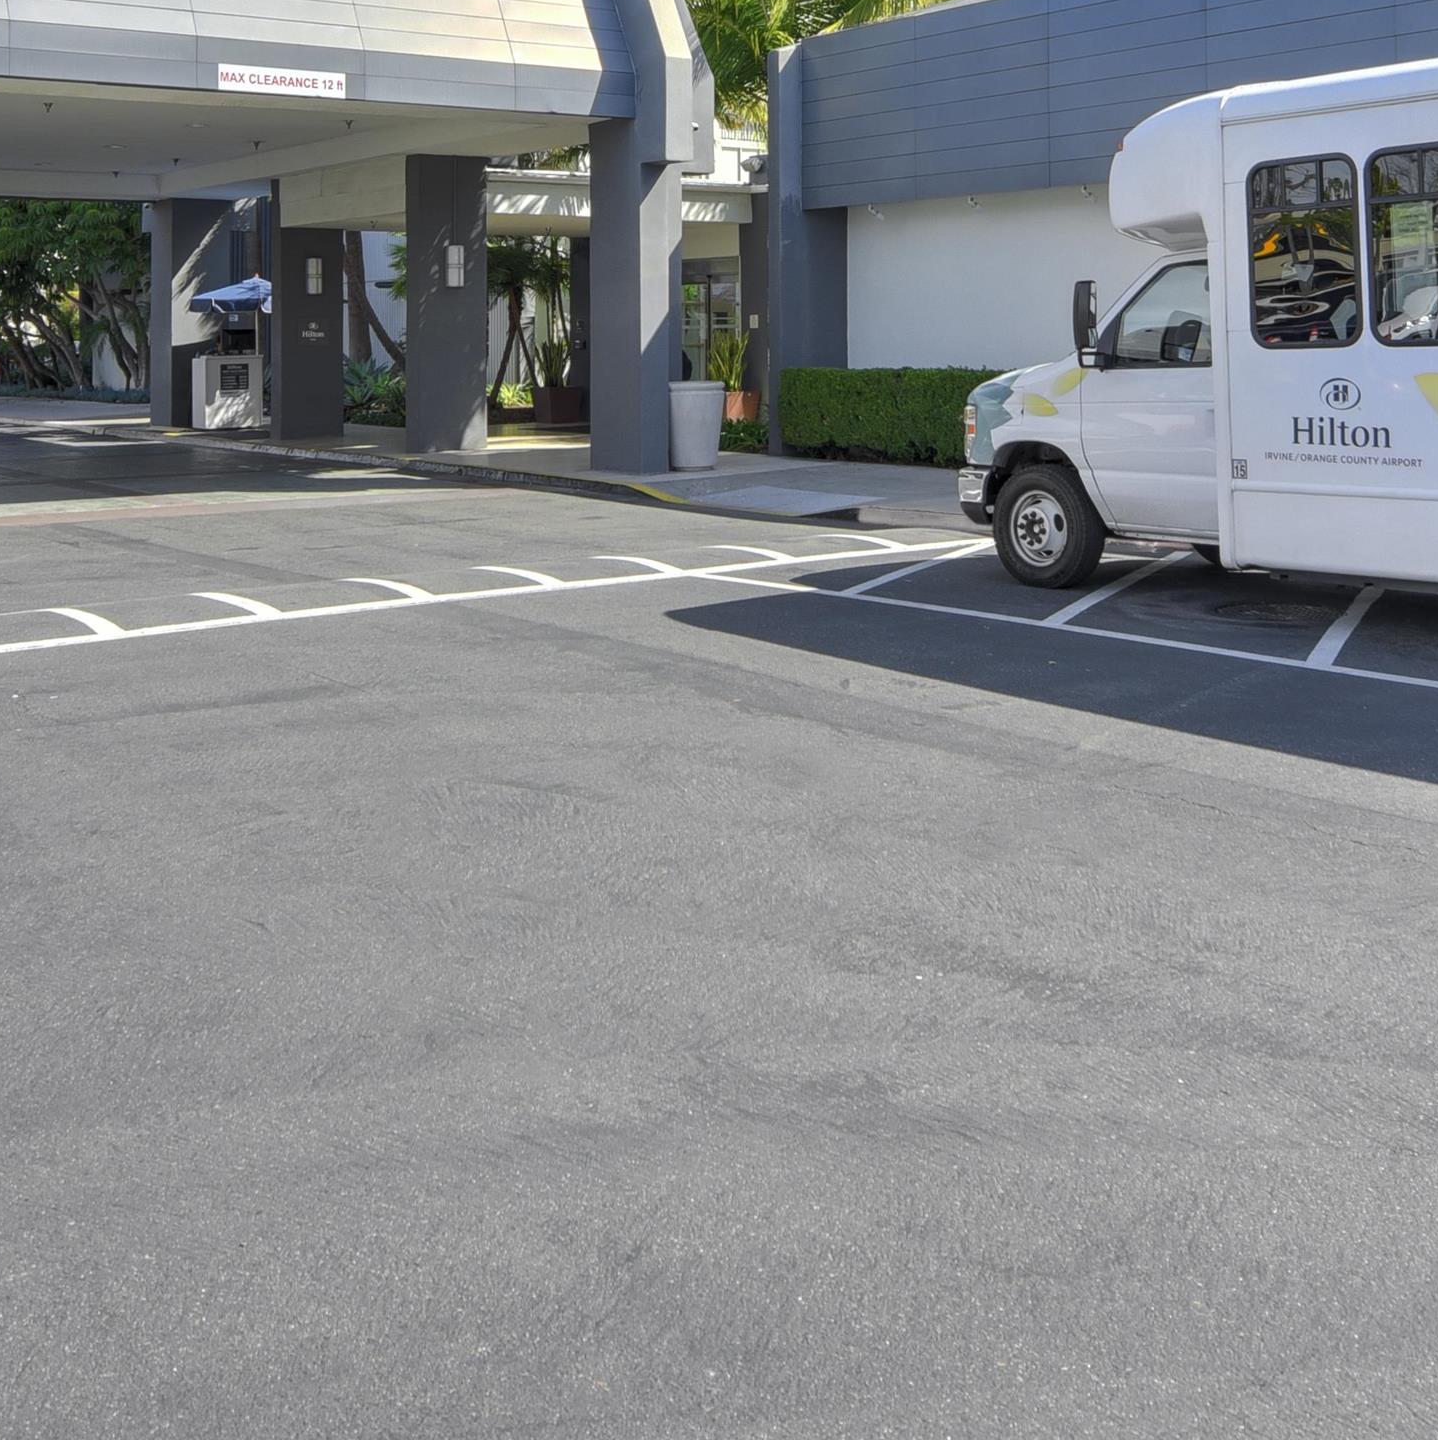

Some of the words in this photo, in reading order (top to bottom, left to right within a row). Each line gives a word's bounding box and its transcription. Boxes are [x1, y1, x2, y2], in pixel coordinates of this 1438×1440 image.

[219, 71, 246, 84] MAX
[248, 73, 319, 89] CLEARANCE
[322, 79, 334, 90] 12
[336, 80, 344, 91] ft
[302, 330, 325, 338] Hilton
[1292, 416, 1392, 449] Hilton
[1340, 455, 1379, 466] COUNTY
[1380, 458, 1424, 468] AIRPORT
[1234, 464, 1246, 478] 15
